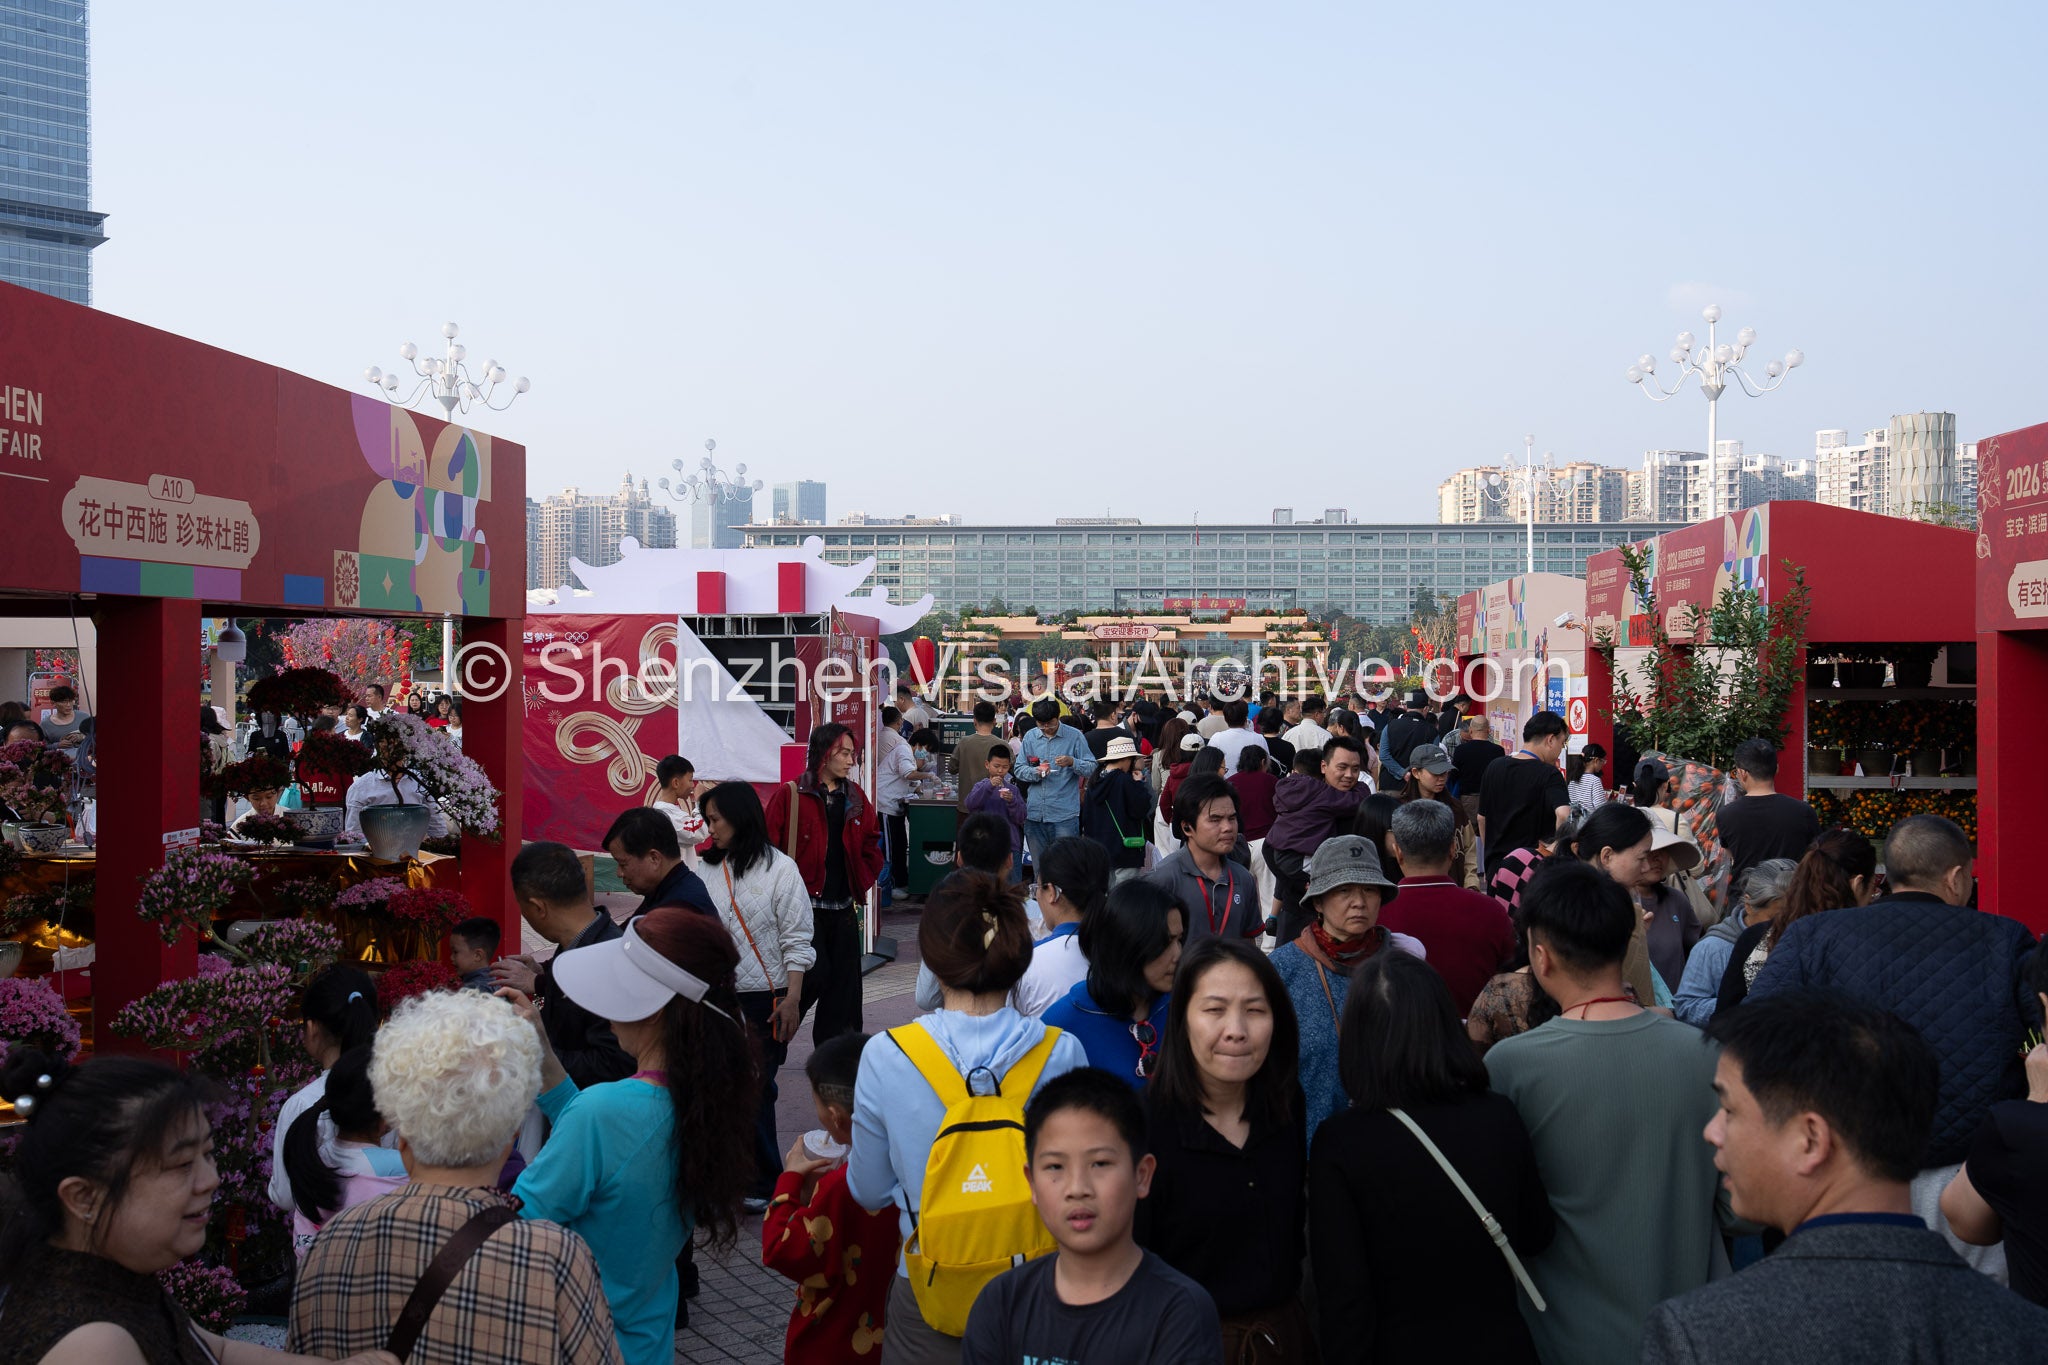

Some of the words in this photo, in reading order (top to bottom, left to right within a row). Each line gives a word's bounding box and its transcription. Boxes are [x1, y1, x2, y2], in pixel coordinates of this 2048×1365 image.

[161, 478, 183, 499] A10
[2006, 463, 2040, 501] 2026
[78, 498, 168, 545] 花中西施
[176, 512, 249, 554] 珍珠杜鹃
[534, 632, 555, 644] 蒙牛
[1102, 627, 1149, 636] 宝安迎春花市
[962, 1180, 993, 1193] PEAK
